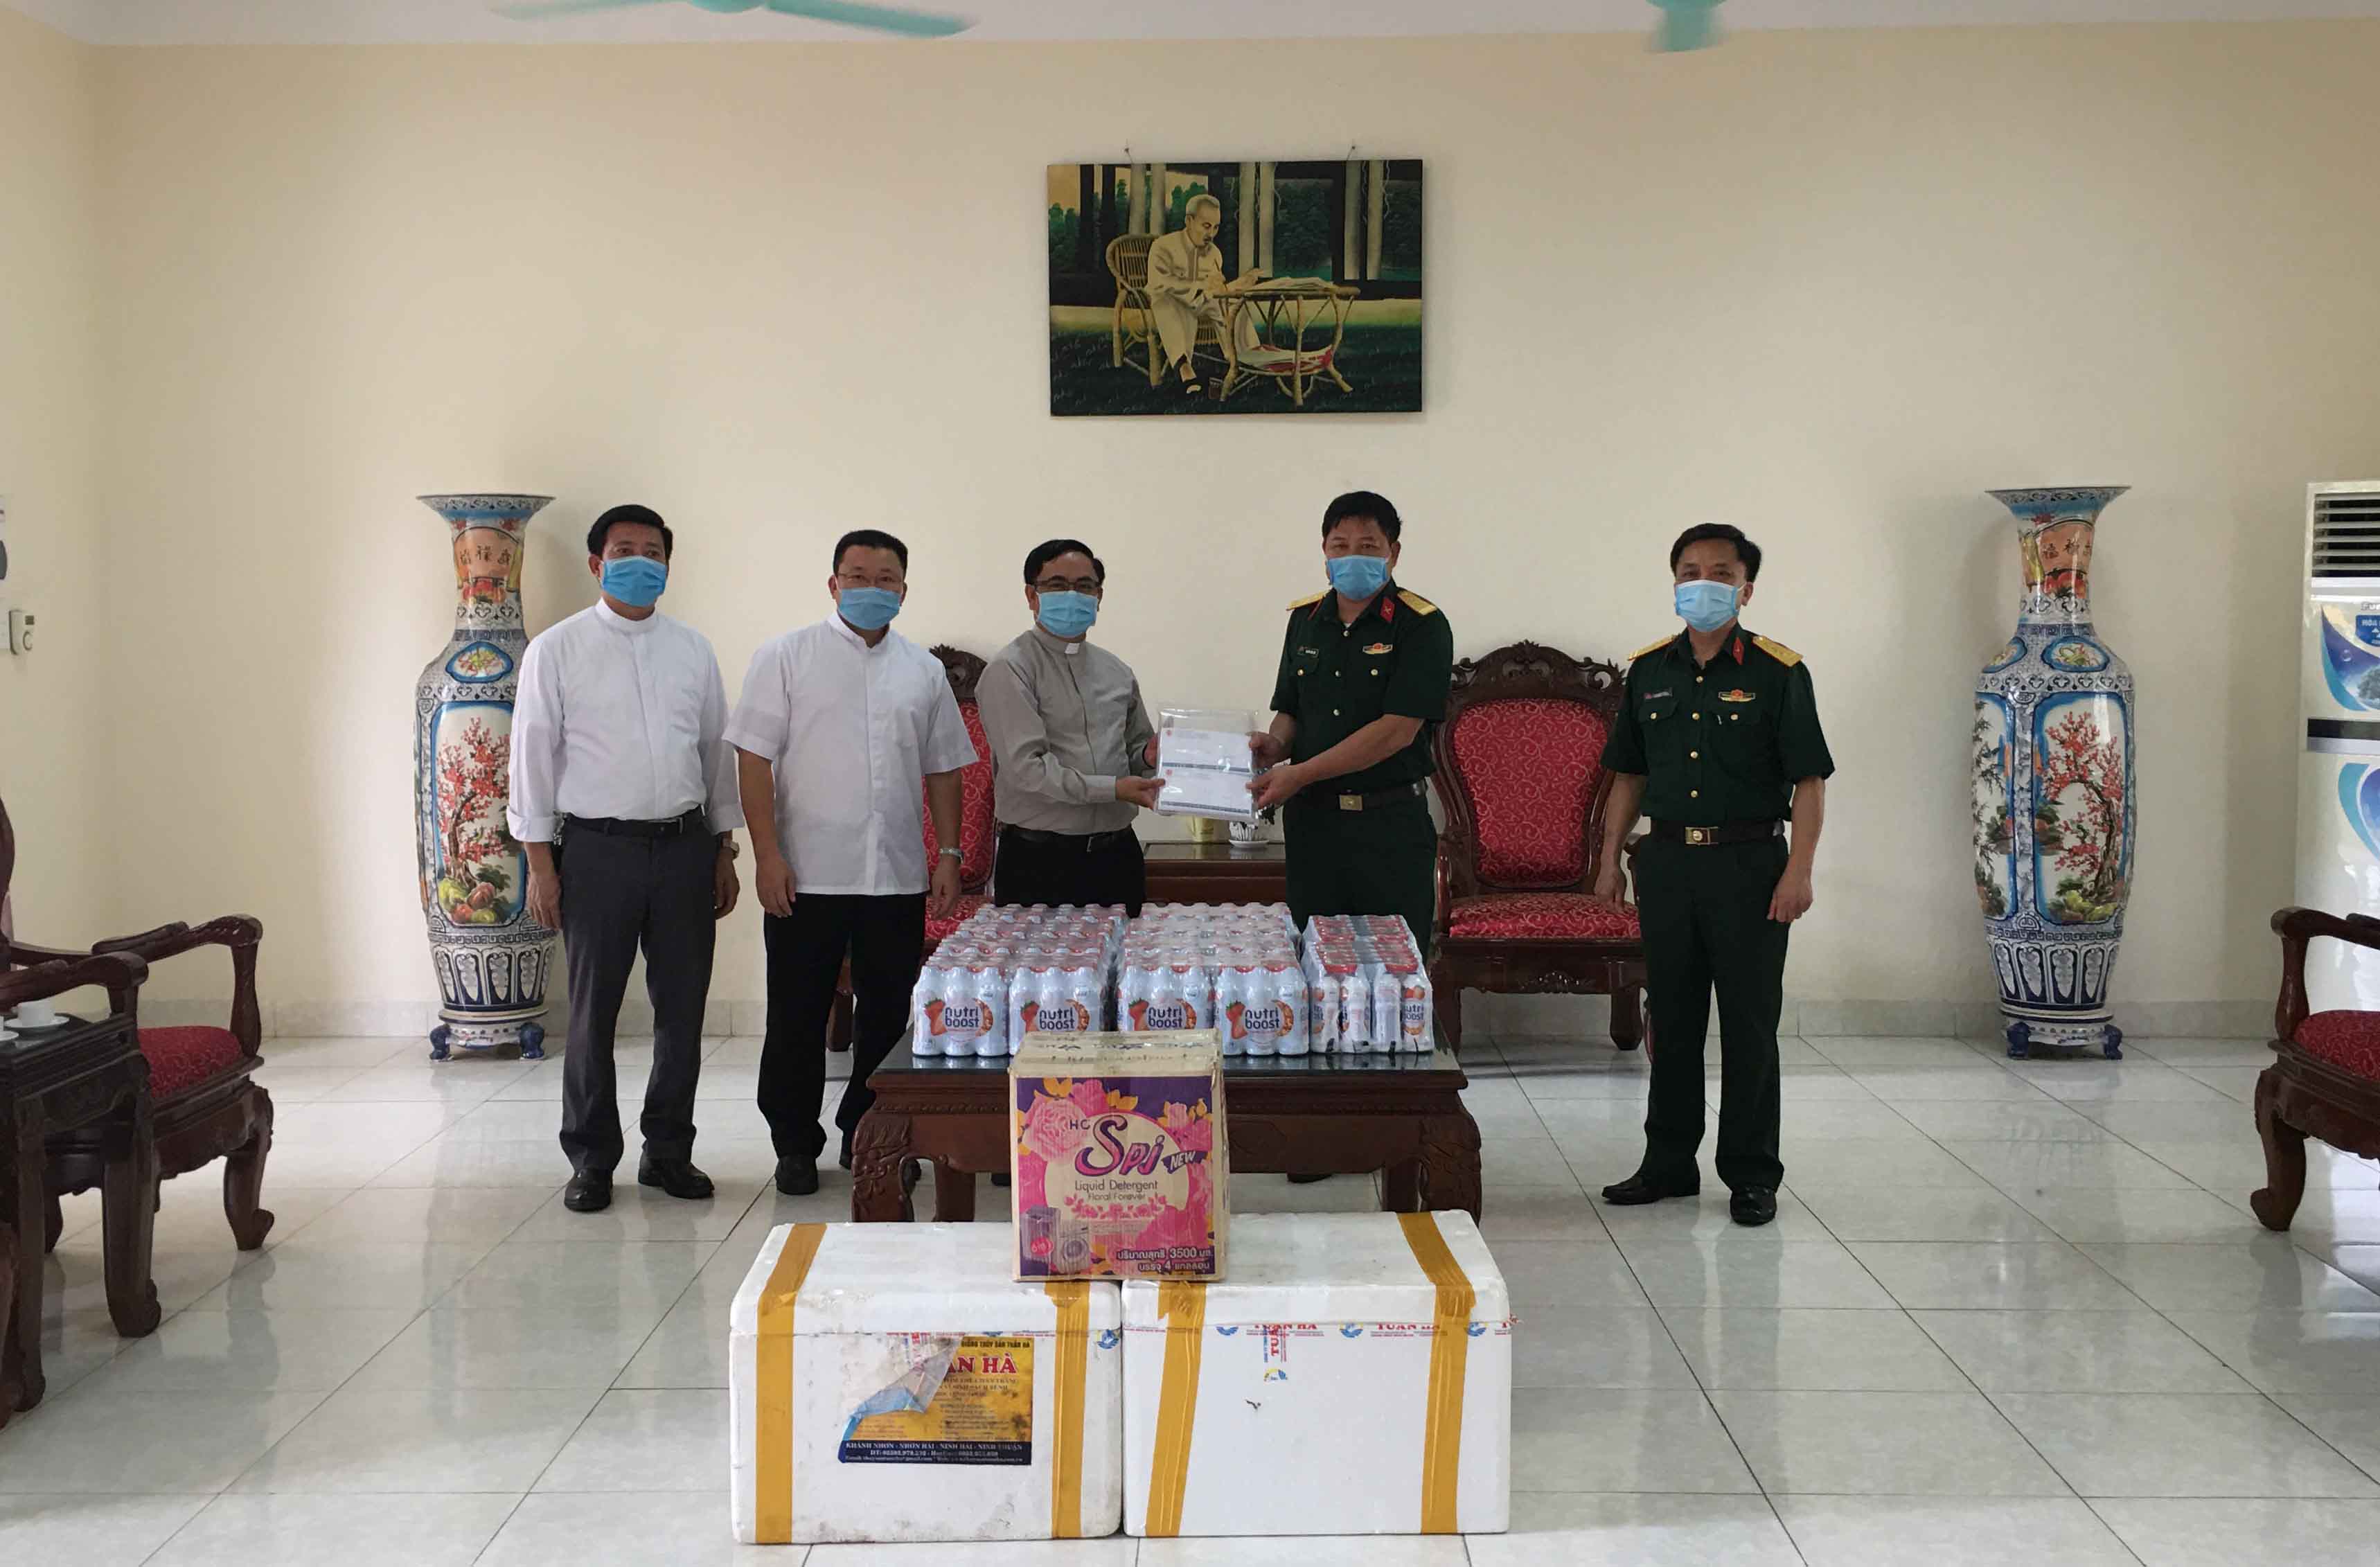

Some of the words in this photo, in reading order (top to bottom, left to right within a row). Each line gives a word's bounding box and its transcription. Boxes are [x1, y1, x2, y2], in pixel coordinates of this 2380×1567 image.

[945, 1006, 978, 1017] nutri
[1040, 1009, 1073, 1020] nutri
[1148, 1007, 1182, 1018] nutri
[1245, 1007, 1279, 1018] nutri
[945, 1016, 979, 1028] boost
[1040, 1018, 1074, 1030] boost
[1148, 1016, 1183, 1029] boost
[1245, 1017, 1280, 1029] boost
[1170, 1151, 1196, 1172] NEW
[1074, 1178, 1105, 1193] Liquid
[1109, 1179, 1158, 1192] Detergent
[1087, 1192, 1111, 1200] Floral
[1169, 1247, 1197, 1259] 3500
[1164, 1260, 1171, 1269] 4
[982, 1352, 1017, 1373] HÀ
